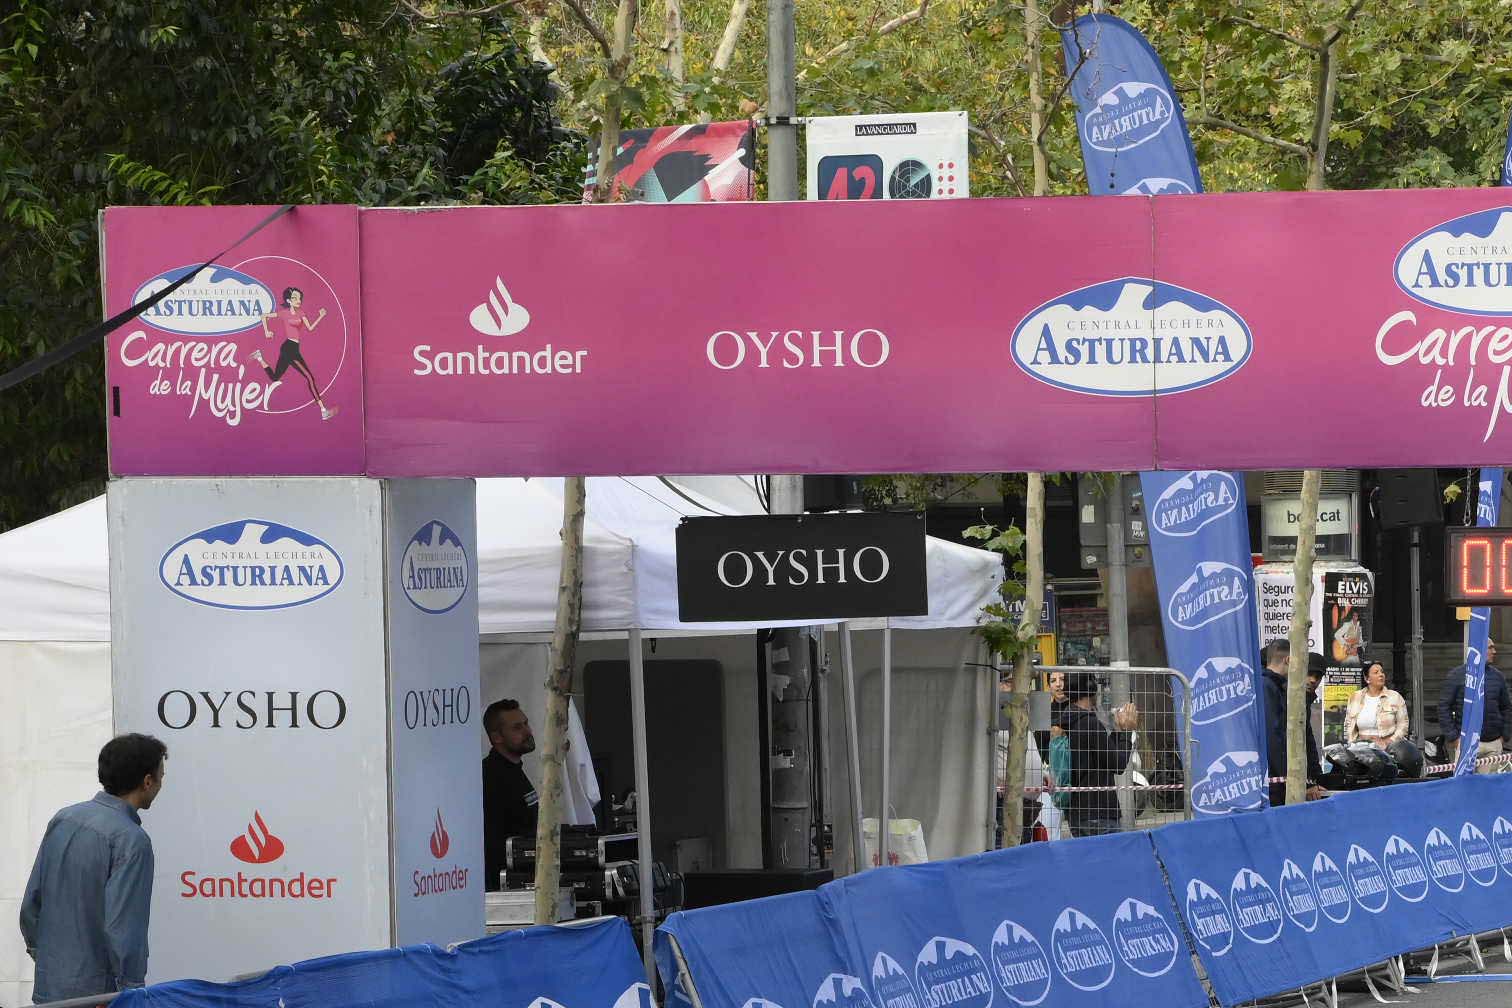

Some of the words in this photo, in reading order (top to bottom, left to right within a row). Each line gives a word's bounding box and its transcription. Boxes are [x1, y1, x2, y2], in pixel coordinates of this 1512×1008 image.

[1067, 319, 1142, 331] CENTRAL
[1149, 317, 1226, 330] LECHERA
[119, 330, 239, 368] Carrera
[413, 344, 588, 376] Santander
[706, 328, 890, 369] OYSHO
[1029, 321, 1233, 365] ASTURIANA
[150, 370, 172, 395] de
[176, 369, 193, 395] la
[189, 364, 282, 427] Mujer
[1421, 368, 1455, 408] de
[1463, 368, 1489, 407] la
[174, 553, 330, 588] ASTURIANA
[202, 551, 260, 560] CENTRAL
[264, 551, 325, 560] LECHERA
[407, 555, 465, 591] ASTURIANA
[717, 546, 891, 588] OYSHO
[1337, 581, 1368, 594] ELVIS
[157, 689, 347, 730] OYSHO
[403, 685, 470, 730] OYSHO
[180, 870, 338, 899] Santander
[413, 864, 469, 898] Santander
[997, 956, 1048, 987] ASTURIANA
[1057, 942, 1113, 973] ASTURIANA
